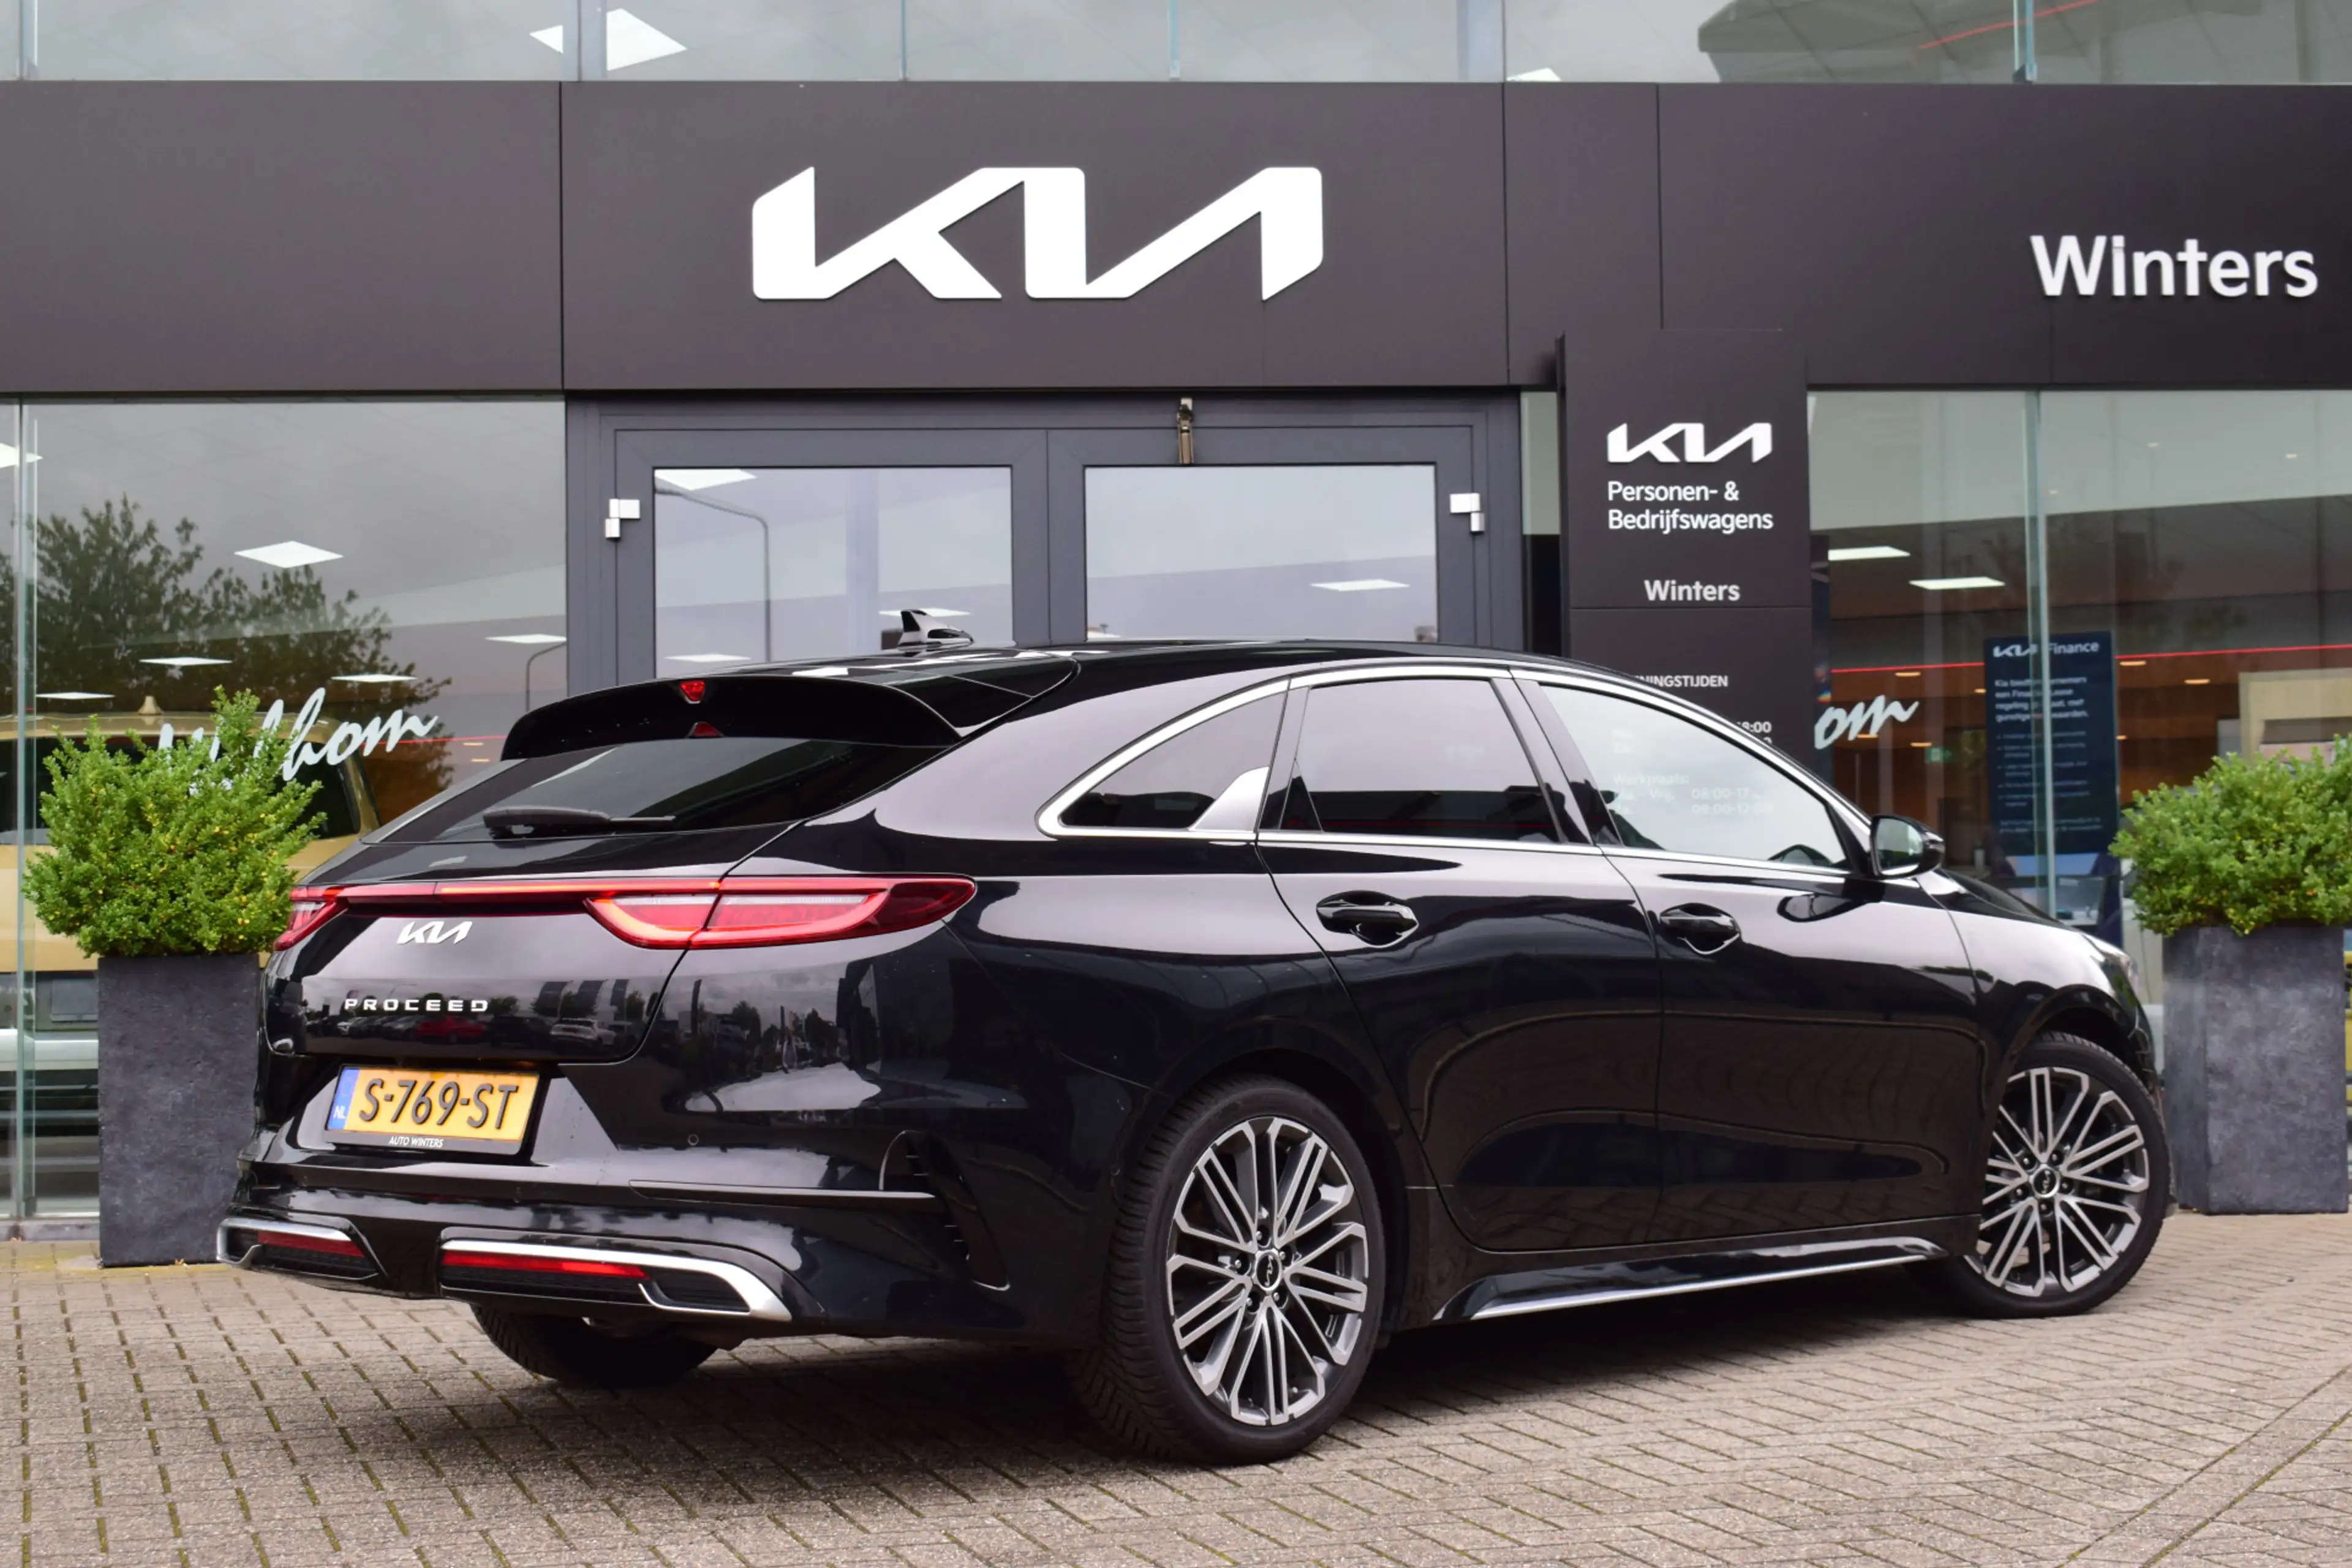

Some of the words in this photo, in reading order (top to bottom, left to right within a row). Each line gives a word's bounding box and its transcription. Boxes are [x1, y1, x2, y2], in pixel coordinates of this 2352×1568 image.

[752, 166, 1324, 301] KIA
[2030, 235, 2318, 297] Winters
[1607, 422, 1773, 463] KIA
[1607, 480, 1719, 502] Personen-
[1724, 480, 1740, 502] &
[1608, 508, 1774, 535] Bedrijfswagens
[1643, 579, 1741, 601] Winters
[396, 921, 473, 944] KIA
[344, 998, 488, 1012] PROCEED
[333, 1105, 347, 1120] NL
[359, 1078, 519, 1129] S-769-ST
[388, 1136, 410, 1146] AUTO
[411, 1137, 445, 1148] WINTERS
